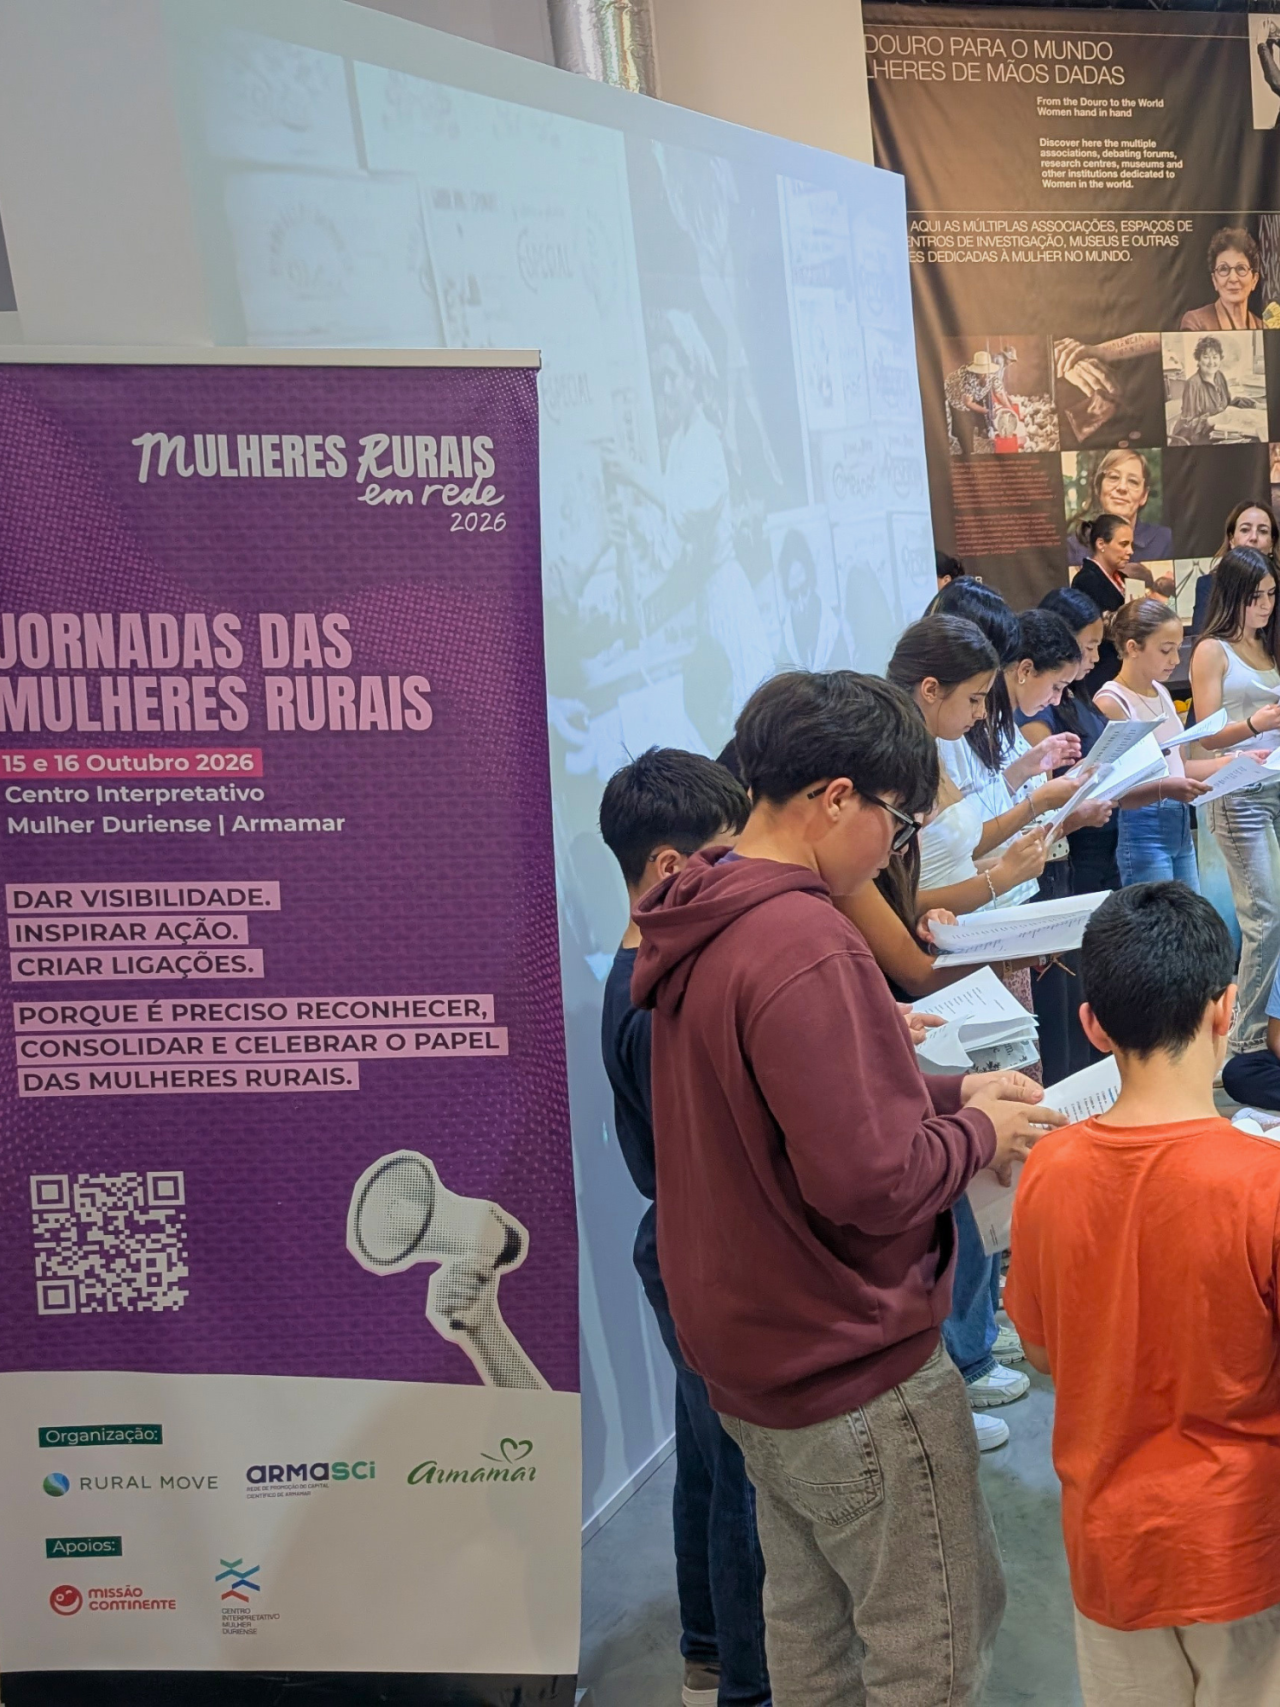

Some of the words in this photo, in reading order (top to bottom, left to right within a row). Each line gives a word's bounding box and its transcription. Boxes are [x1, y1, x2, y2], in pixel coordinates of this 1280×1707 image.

[950, 38, 1007, 58] PARA
[1011, 39, 1028, 58] O
[1035, 40, 1113, 61] MUNDO
[952, 62, 981, 82] DE
[987, 59, 1049, 84] MÃOS
[1055, 64, 1125, 85] DADAS
[1037, 97, 1061, 106] From
[1063, 97, 1077, 106] the
[1080, 97, 1108, 107] Douro
[1110, 99, 1119, 107] to
[1122, 99, 1136, 107] the
[1138, 98, 1164, 108] World
[1037, 107, 1072, 116] Women
[1074, 108, 1097, 117] hand
[1099, 108, 1107, 117] in
[1109, 108, 1132, 117] hand
[1040, 138, 1080, 147] Discover
[1082, 139, 1102, 147] here
[1104, 139, 1119, 148] the
[1121, 139, 1156, 148] multiple
[1040, 149, 1100, 158] associations,
[1102, 149, 1141, 159] debating
[1143, 150, 1177, 159] forums,
[1041, 159, 1081, 168] research
[1083, 160, 1119, 169] centres,
[1167, 160, 1183, 168] and
[1042, 170, 1066, 178] other
[1068, 170, 1118, 178] institutions
[1120, 170, 1163, 178] dedicated
[1042, 180, 1076, 188] Women
[1079, 180, 1087, 188] in
[1089, 180, 1104, 188] the
[1106, 180, 1134, 188] world.
[911, 220, 941, 232] AQUI
[944, 220, 960, 232] AS
[963, 217, 1028, 232] MÚLTIPLAS
[1031, 219, 1118, 234] ASSOCIAÇÕES,
[1121, 220, 1175, 234] ESPAÇOS
[1177, 220, 1192, 231] DE
[958, 236, 974, 247] DE
[977, 235, 1067, 249] INVESTIGAÇÃO,
[1069, 236, 1119, 247] MUSEUS
[1122, 236, 1129, 247] E
[1132, 236, 1179, 247] OUTRAS
[928, 250, 997, 262] DEDICADAS
[1001, 249, 1010, 262] À
[1012, 250, 1062, 262] MULHER
[1065, 250, 1083, 262] NO
[1086, 250, 1133, 261] MUNDO.
[132, 432, 348, 483] MULHERES
[356, 434, 496, 483] RURAIS
[358, 483, 414, 506] em
[421, 477, 505, 507] rede
[450, 512, 507, 533] 2026
[0, 613, 244, 669] JORNADAS
[260, 613, 353, 670] DAS
[0, 676, 249, 732] MULHERES
[265, 675, 433, 731] RURAIS
[2, 754, 24, 773] 15
[32, 758, 48, 773] e
[54, 754, 80, 773] 16
[86, 752, 190, 773] Outubro
[195, 753, 255, 772] 2026
[5, 784, 90, 805] Centro
[97, 783, 265, 807] Interpretativo
[8, 814, 95, 835] Mulher
[102, 813, 212, 835] Duriense
[232, 814, 346, 833] Armamar
[13, 889, 73, 910] DAR
[80, 887, 272, 910] VISIBILIDADE.
[15, 921, 147, 944] INSPIRAR
[154, 917, 239, 945] AÇÃO.
[17, 955, 104, 977] CRIAR
[112, 951, 255, 980] LIGAÇÕES.
[18, 1005, 139, 1028] PORQUE
[147, 1000, 164, 1022] É
[172, 1002, 288, 1023] PRECISO
[296, 998, 489, 1021] RECONHECER,
[21, 1037, 203, 1059] CONSOLIDAR
[212, 1037, 227, 1056] E
[235, 1033, 378, 1056] CELEBRAR
[385, 1033, 406, 1053] O
[414, 1032, 499, 1052] PAPEL
[23, 1072, 81, 1093] DAS
[89, 1069, 238, 1090] MULHERES
[245, 1066, 353, 1088] RURAIS.
[45, 1427, 159, 1446] Organização:
[79, 1475, 153, 1491] RURAL
[160, 1474, 219, 1490] MOVE
[52, 1538, 116, 1556] Apoios:
